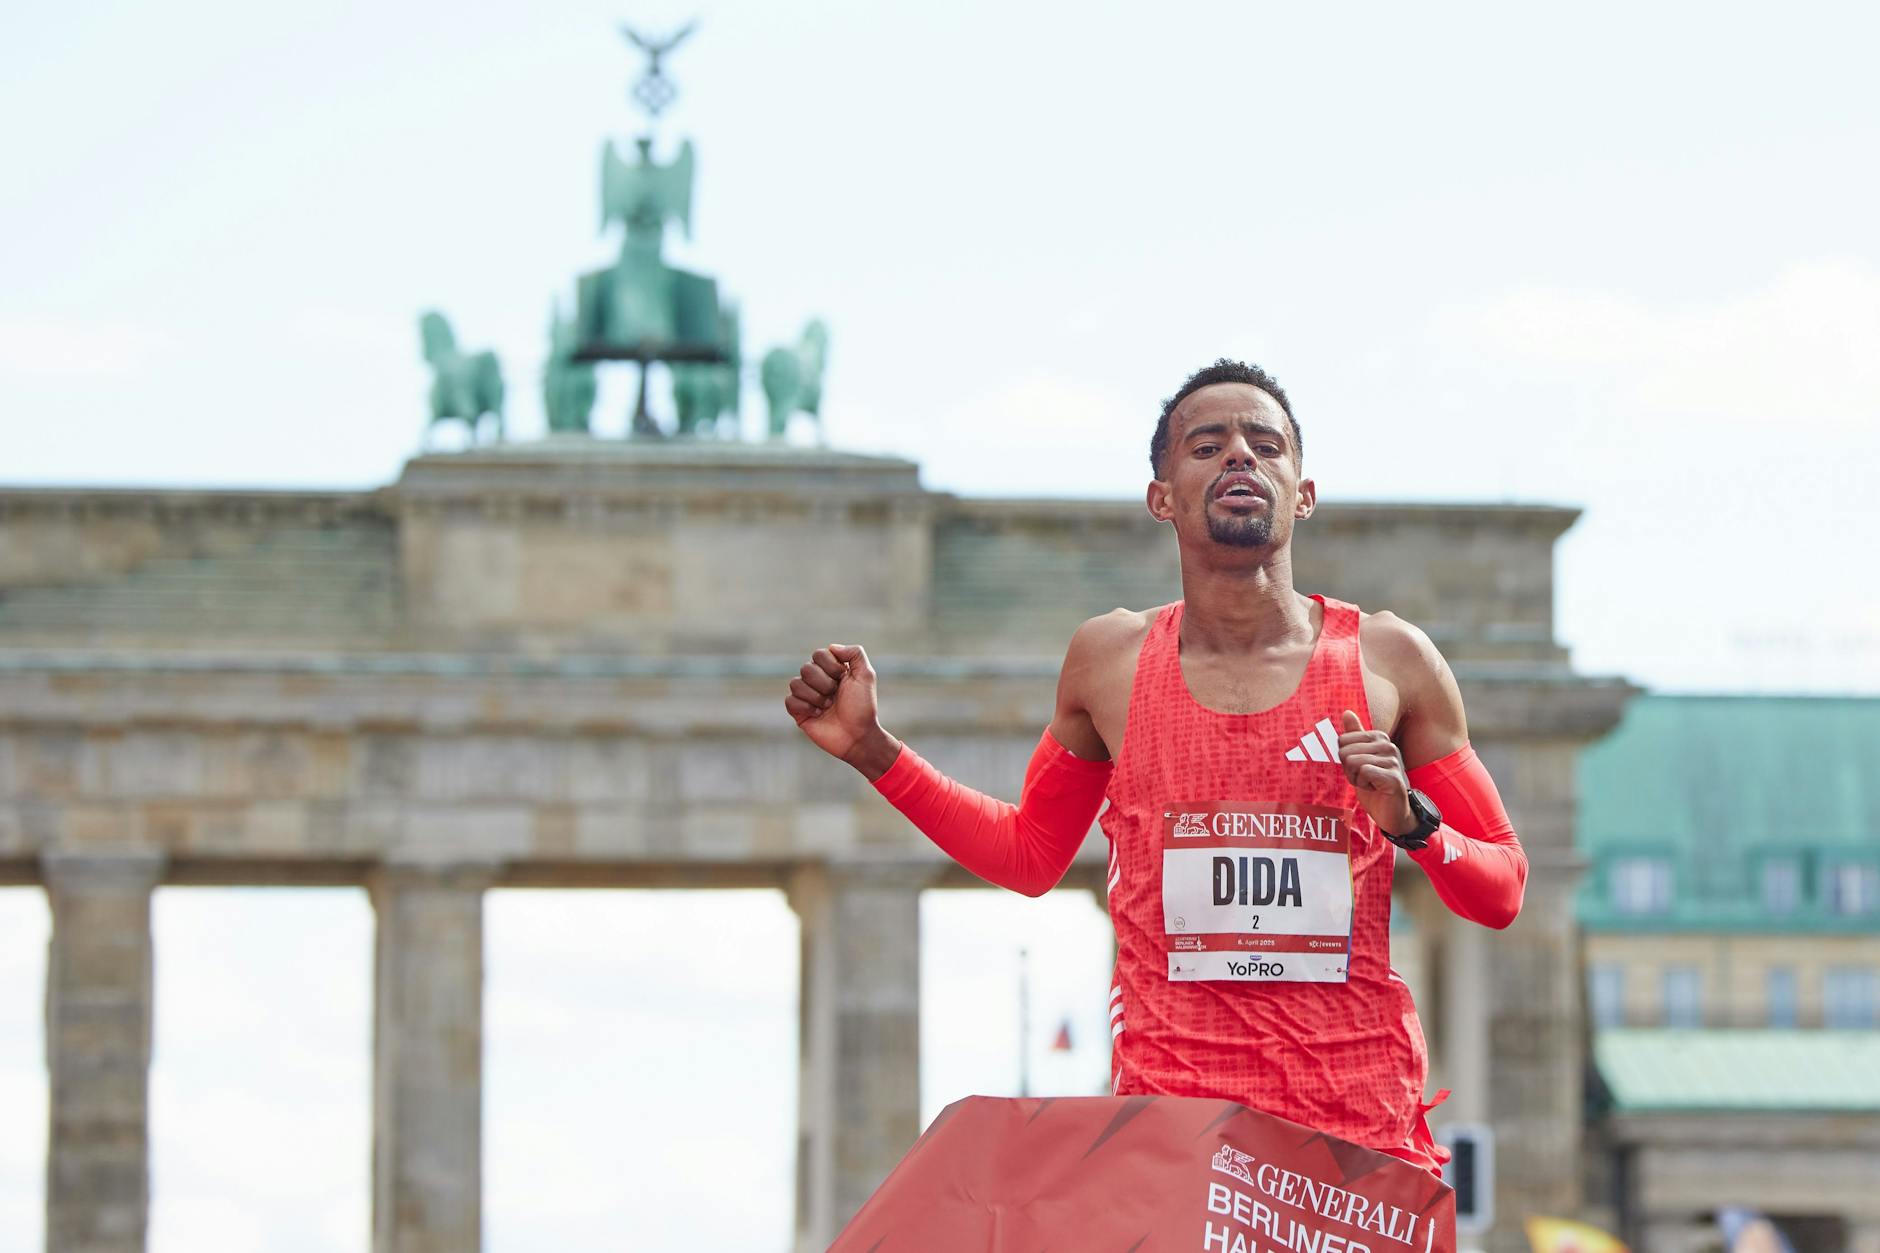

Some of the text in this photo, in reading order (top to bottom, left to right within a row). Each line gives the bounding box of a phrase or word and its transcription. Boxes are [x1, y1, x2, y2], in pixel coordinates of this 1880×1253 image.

[1212, 812, 1339, 842] GENERALI
[1213, 856, 1303, 907] DIDA
[1252, 915, 1260, 930] 2
[1227, 962, 1284, 977] YoPRO
[1257, 1163, 1420, 1246] GENERALI
